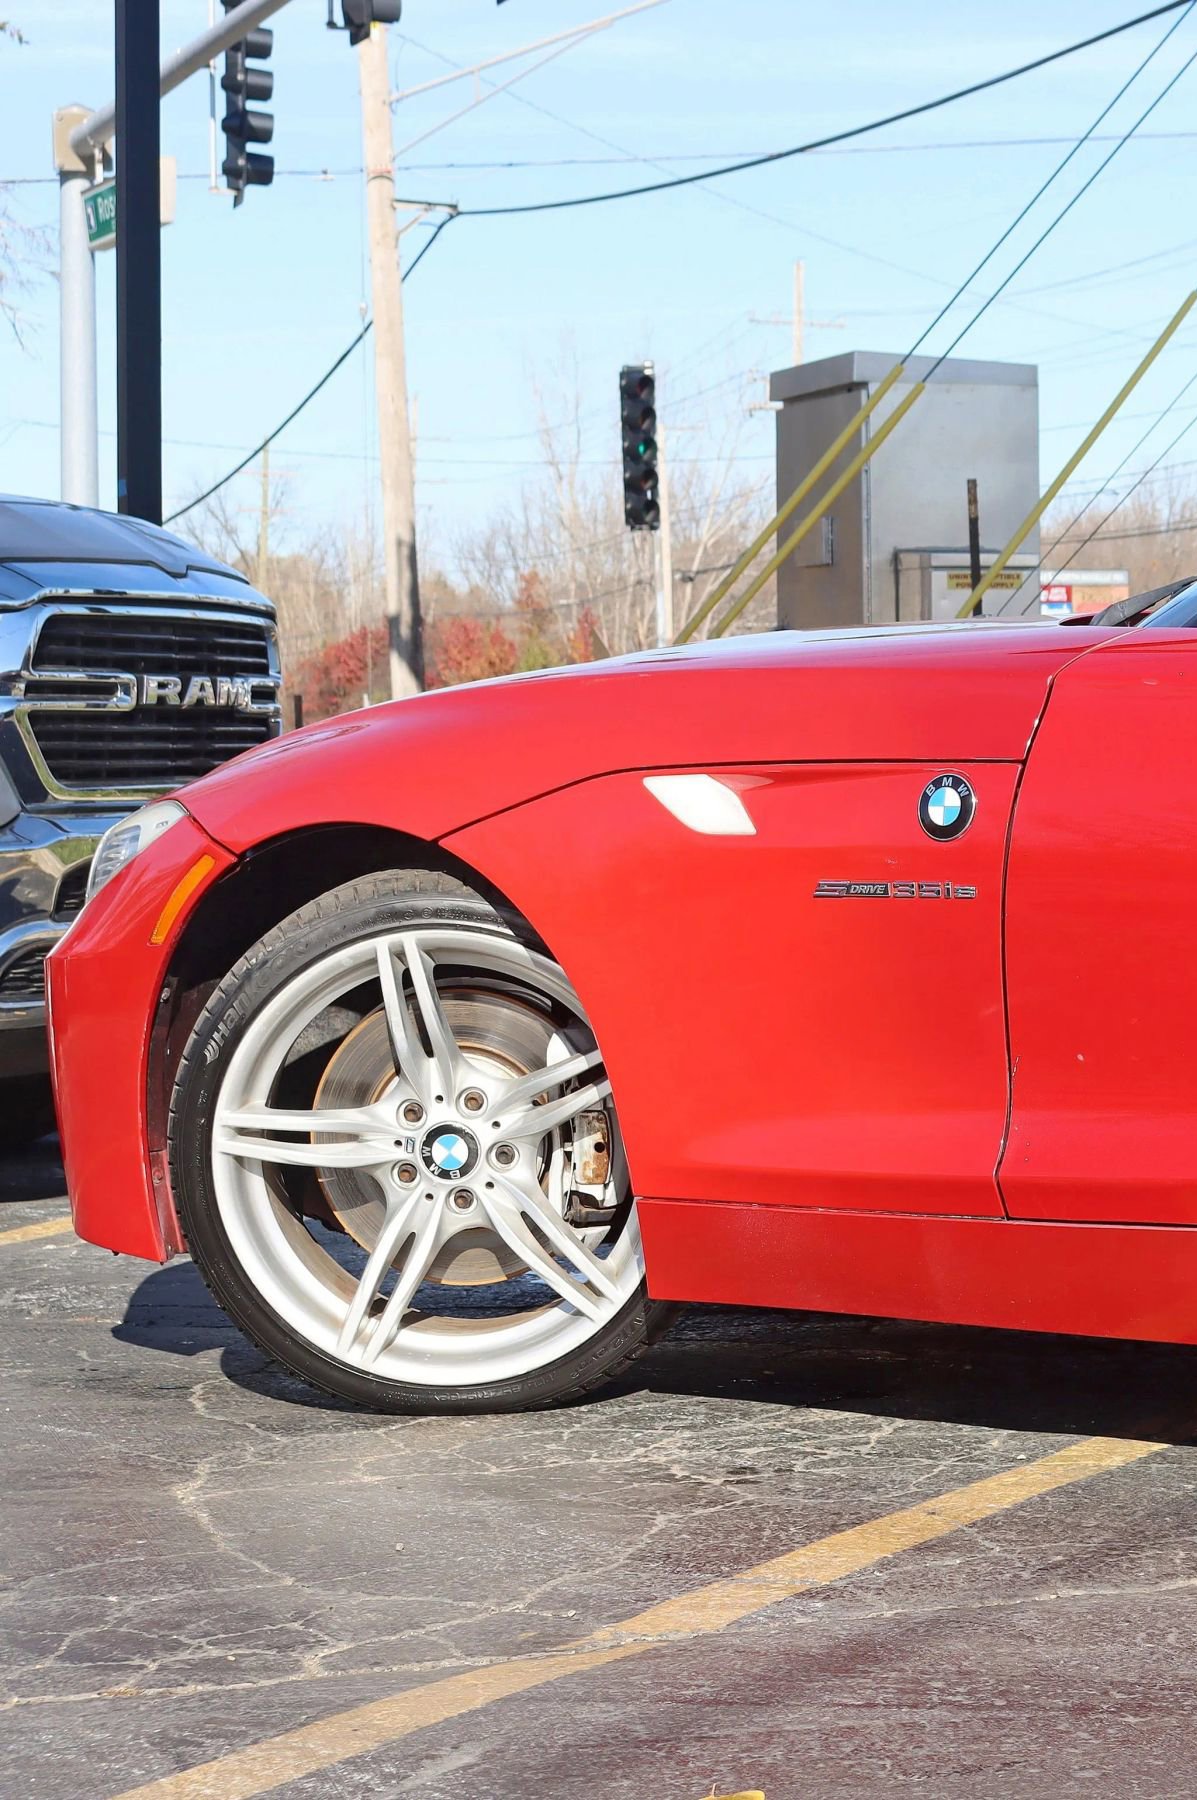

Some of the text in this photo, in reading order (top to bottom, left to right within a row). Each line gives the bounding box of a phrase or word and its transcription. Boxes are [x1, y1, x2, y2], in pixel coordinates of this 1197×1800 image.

[144, 675, 250, 707] RAM
[925, 776, 970, 798] BMW
[421, 1145, 461, 1179] BMW
